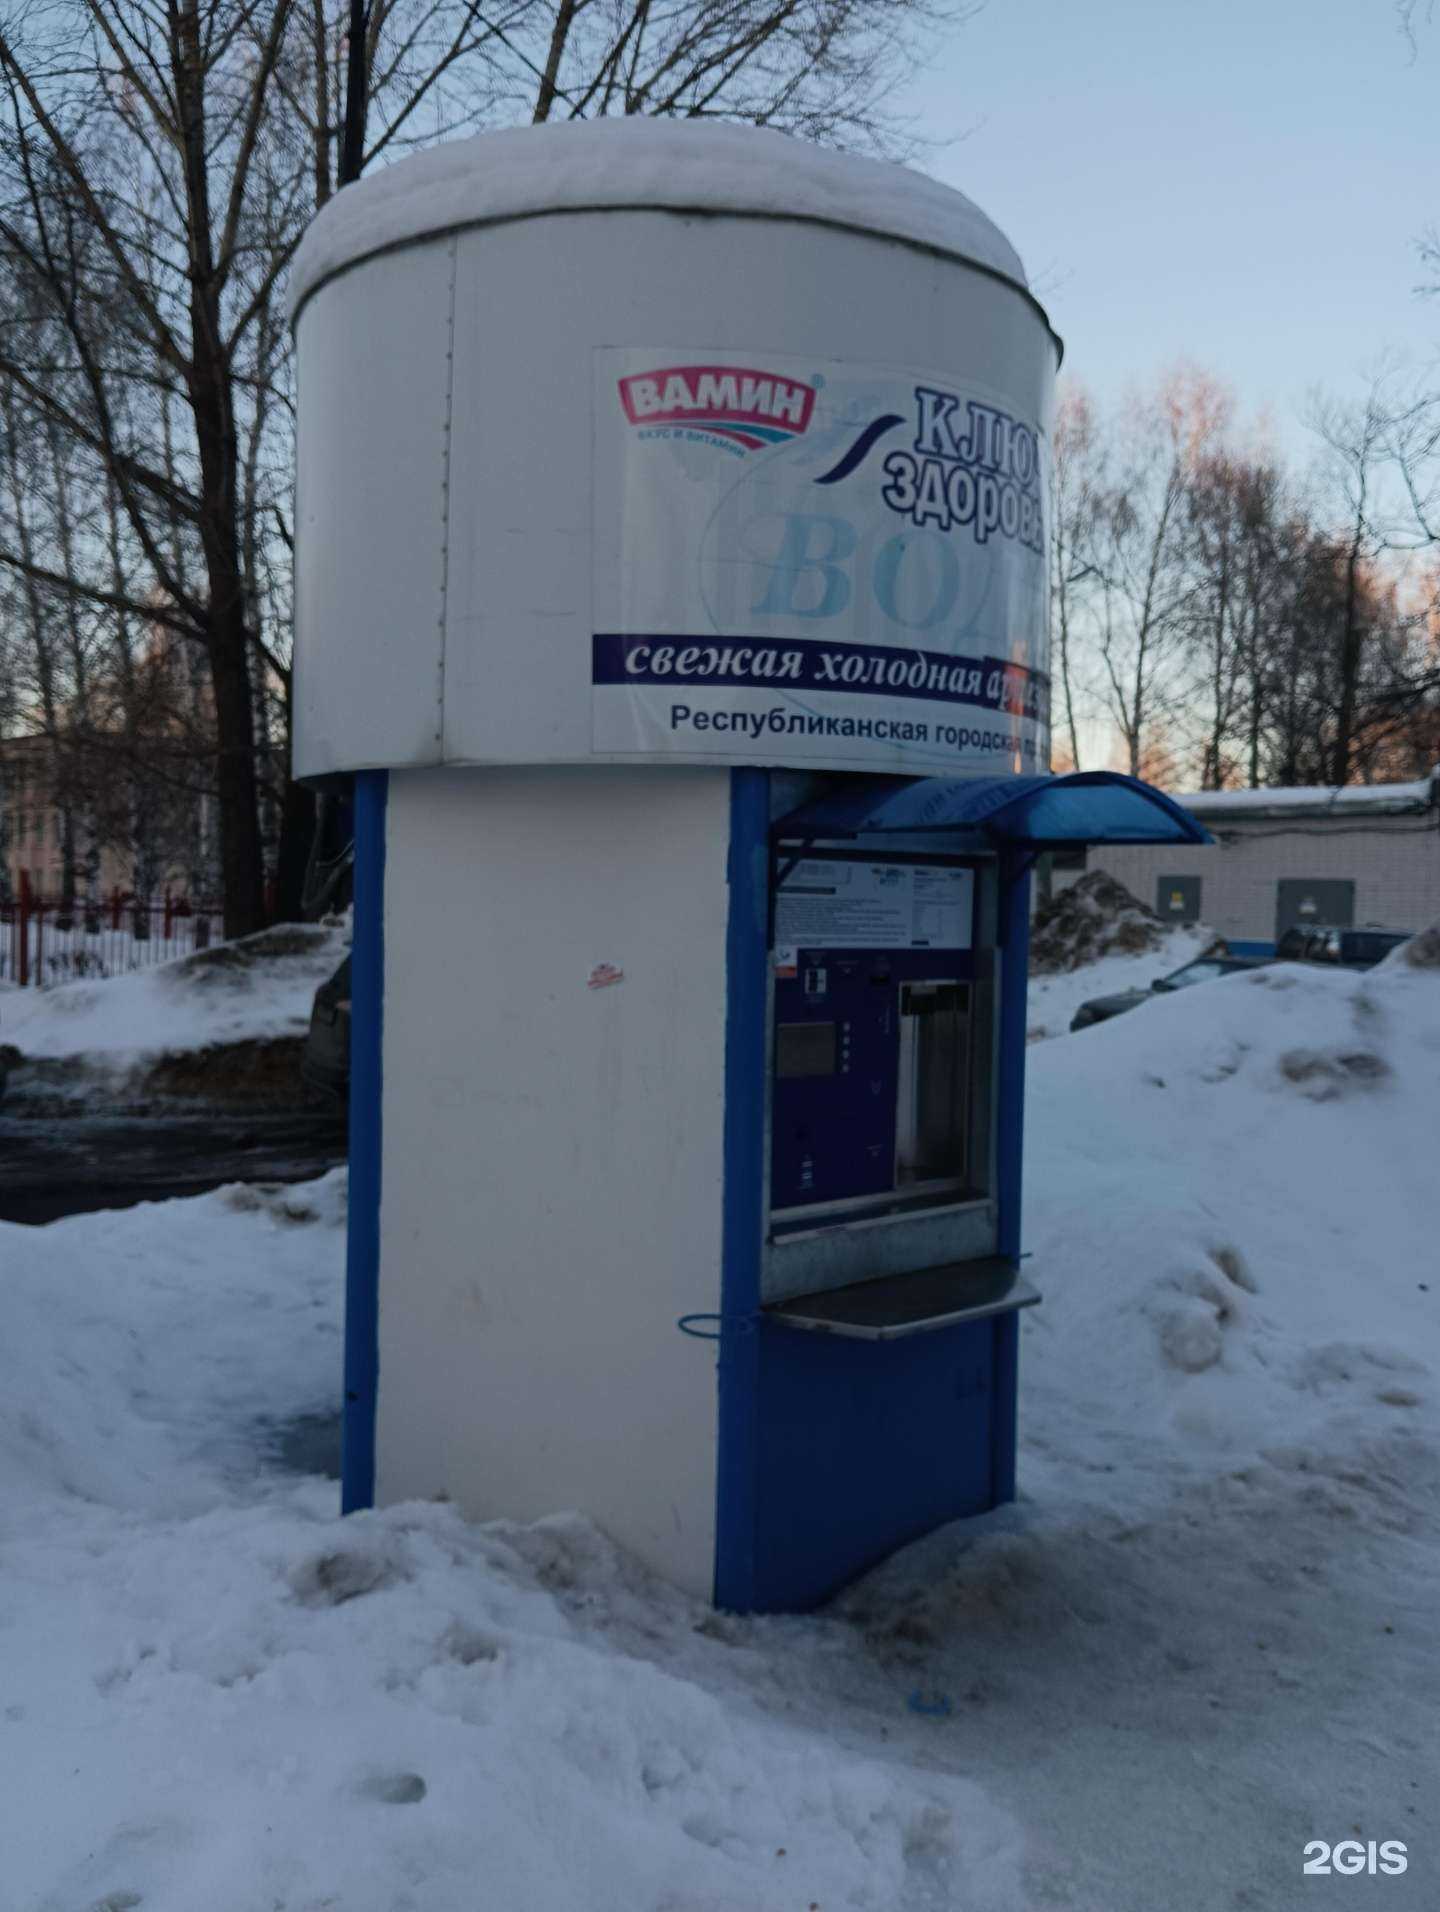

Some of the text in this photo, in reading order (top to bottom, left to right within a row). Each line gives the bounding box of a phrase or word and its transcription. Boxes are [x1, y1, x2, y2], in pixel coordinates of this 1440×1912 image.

[630, 371, 806, 425] ВАМИН
[914, 386, 1042, 490] КЛЮ
[624, 643, 804, 680] свежая
[813, 649, 982, 696] холодная
[671, 704, 928, 742] Республиканская
